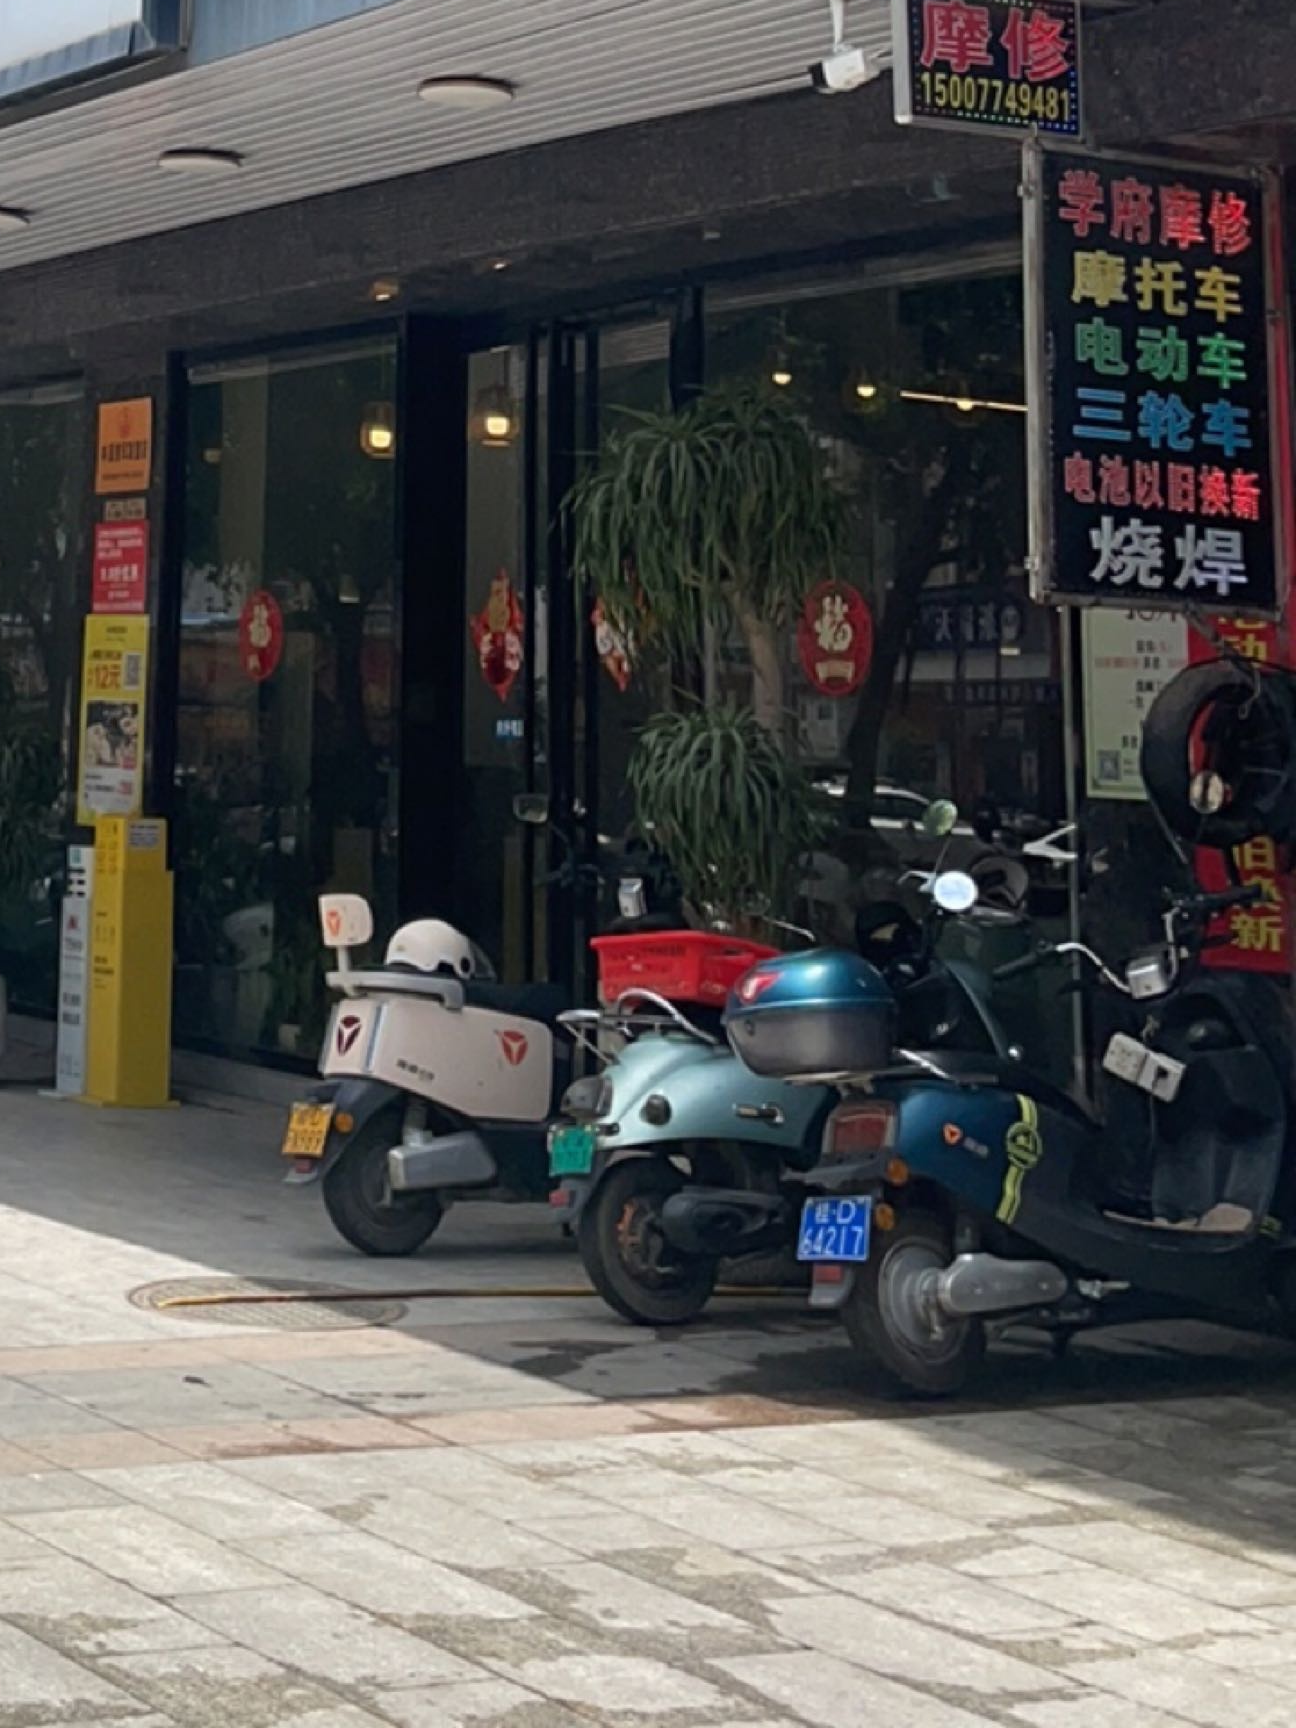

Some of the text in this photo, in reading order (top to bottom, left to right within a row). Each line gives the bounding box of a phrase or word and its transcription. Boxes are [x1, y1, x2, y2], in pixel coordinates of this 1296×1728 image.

[920, 72, 1070, 122] 15007749481
[1058, 168, 1253, 256] 学府摩修
[1070, 249, 1244, 323] 摩托车
[1074, 316, 1248, 390] 电动车
[1071, 387, 1253, 458] 三轮车
[1063, 450, 1262, 522] 电池以旧换新
[1087, 514, 1249, 597] 烧焊
